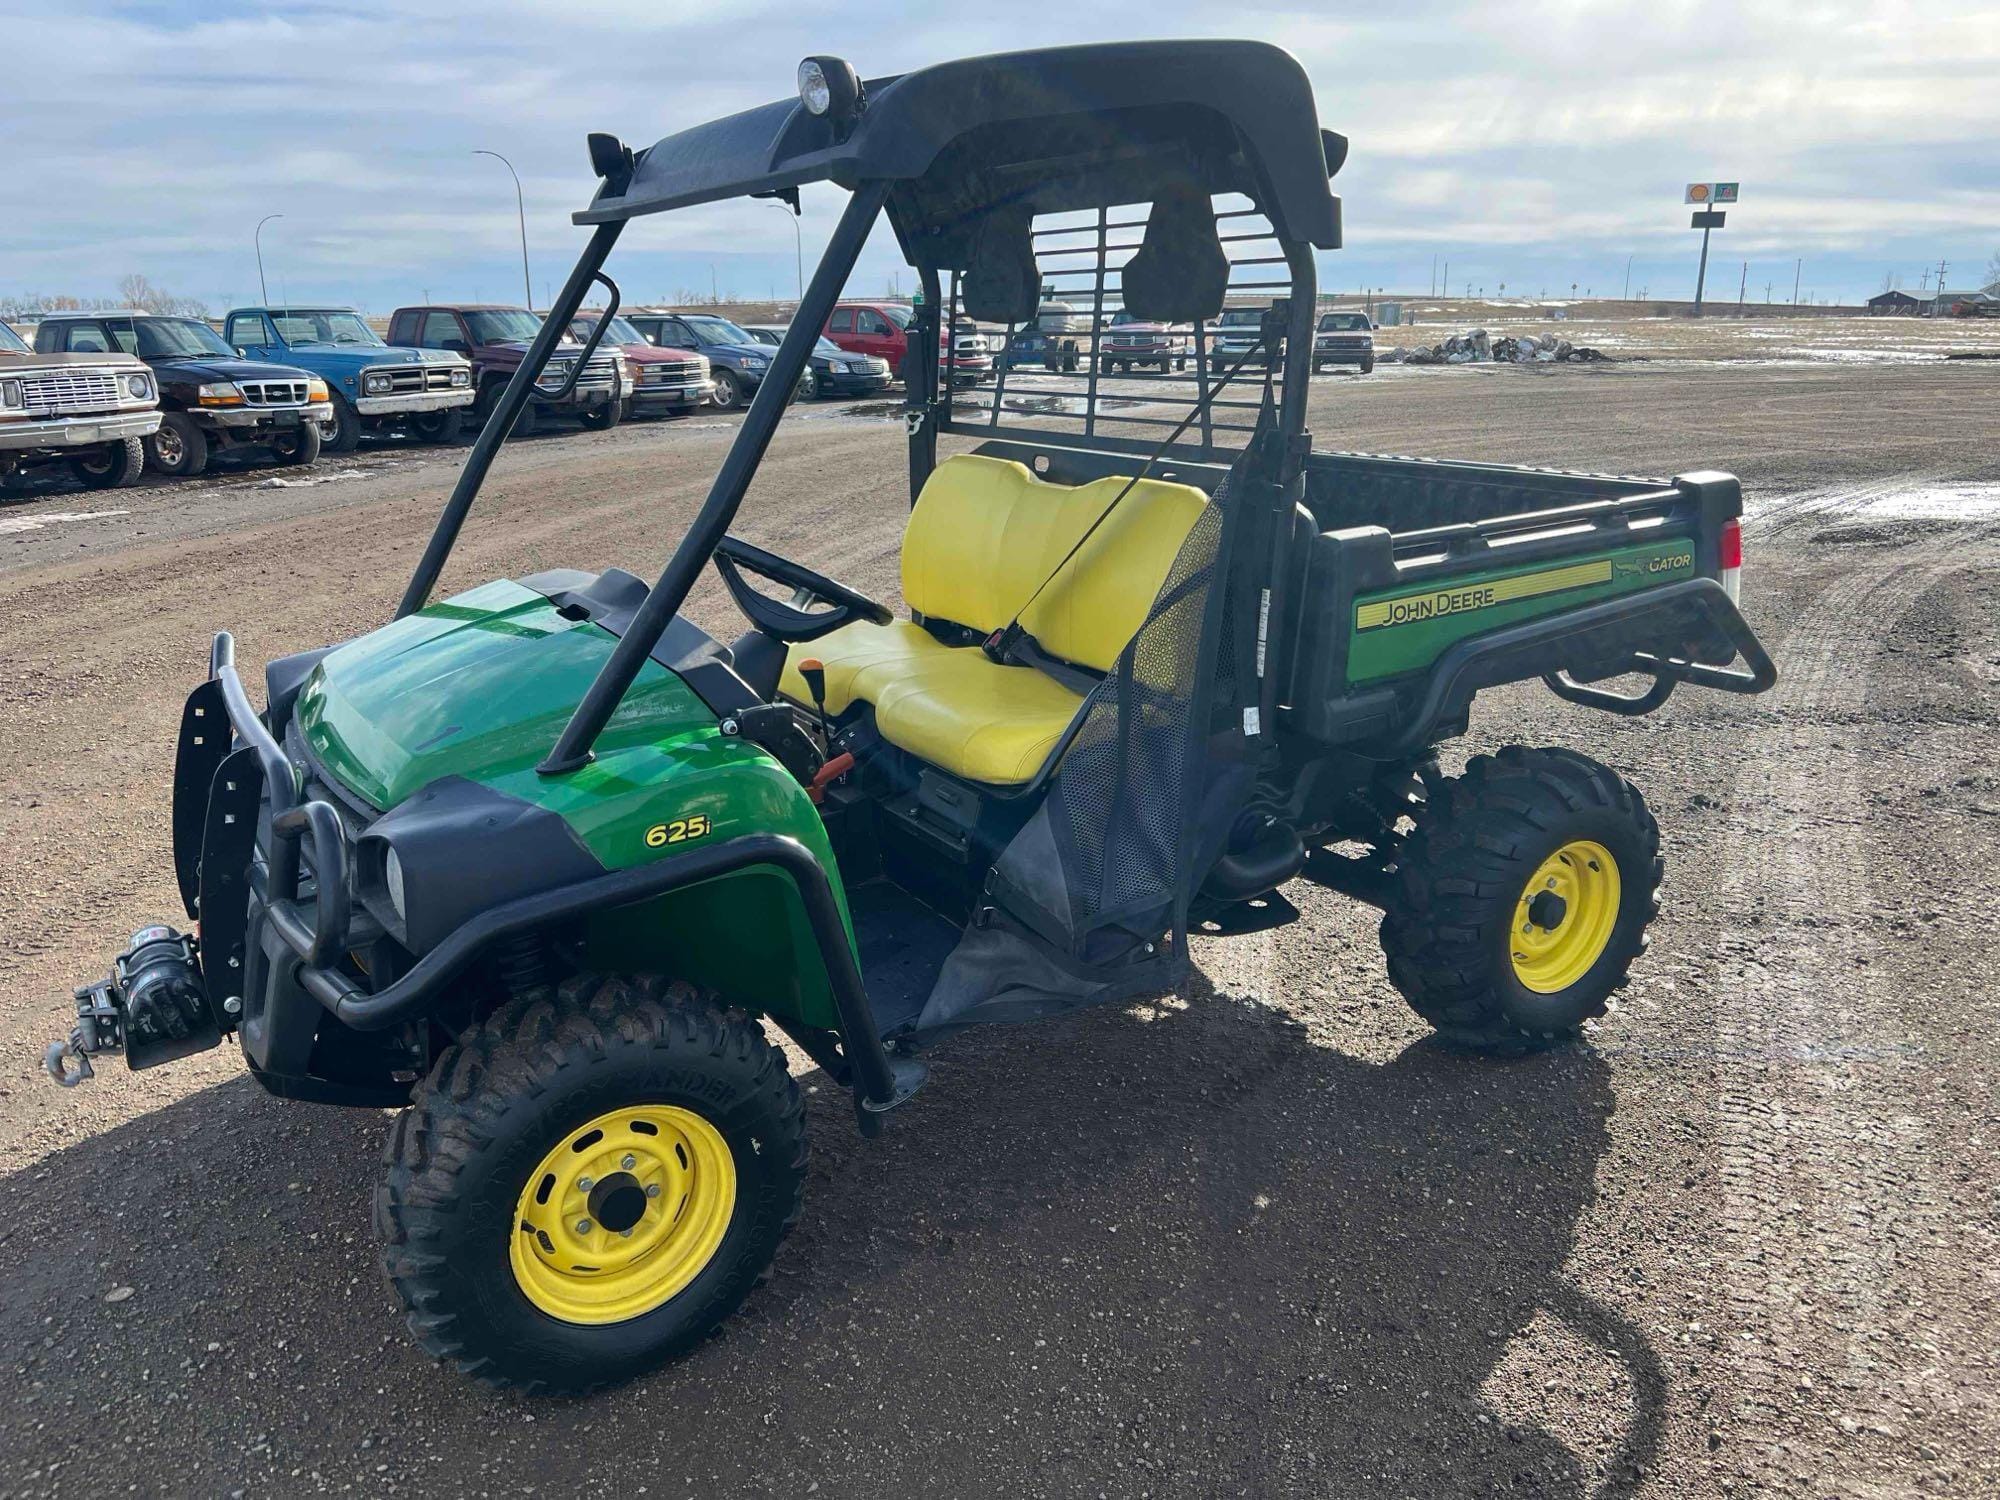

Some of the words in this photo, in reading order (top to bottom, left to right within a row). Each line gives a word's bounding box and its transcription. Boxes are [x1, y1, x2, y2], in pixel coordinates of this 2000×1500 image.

[1649, 554, 1691, 572] GATOR
[1383, 600, 1433, 625] JOHN
[1437, 588, 1494, 613] DEERE
[646, 815, 712, 847] 625i
